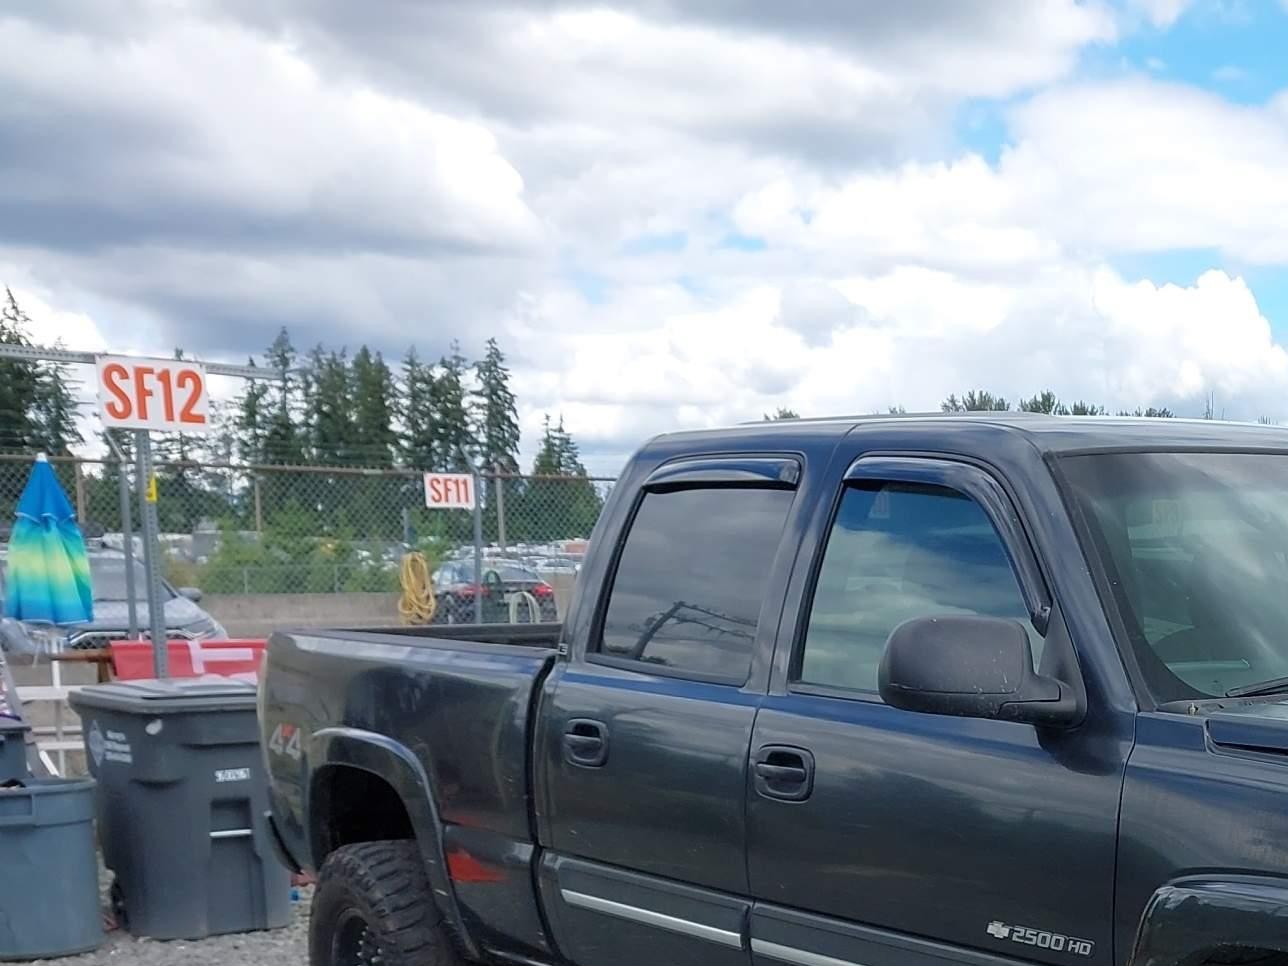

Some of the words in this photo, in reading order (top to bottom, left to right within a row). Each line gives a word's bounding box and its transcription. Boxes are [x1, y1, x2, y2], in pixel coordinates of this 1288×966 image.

[102, 363, 206, 424] SF12
[430, 478, 469, 503] SF11
[1012, 927, 1065, 951] 2500
[1067, 939, 1092, 956] HD
